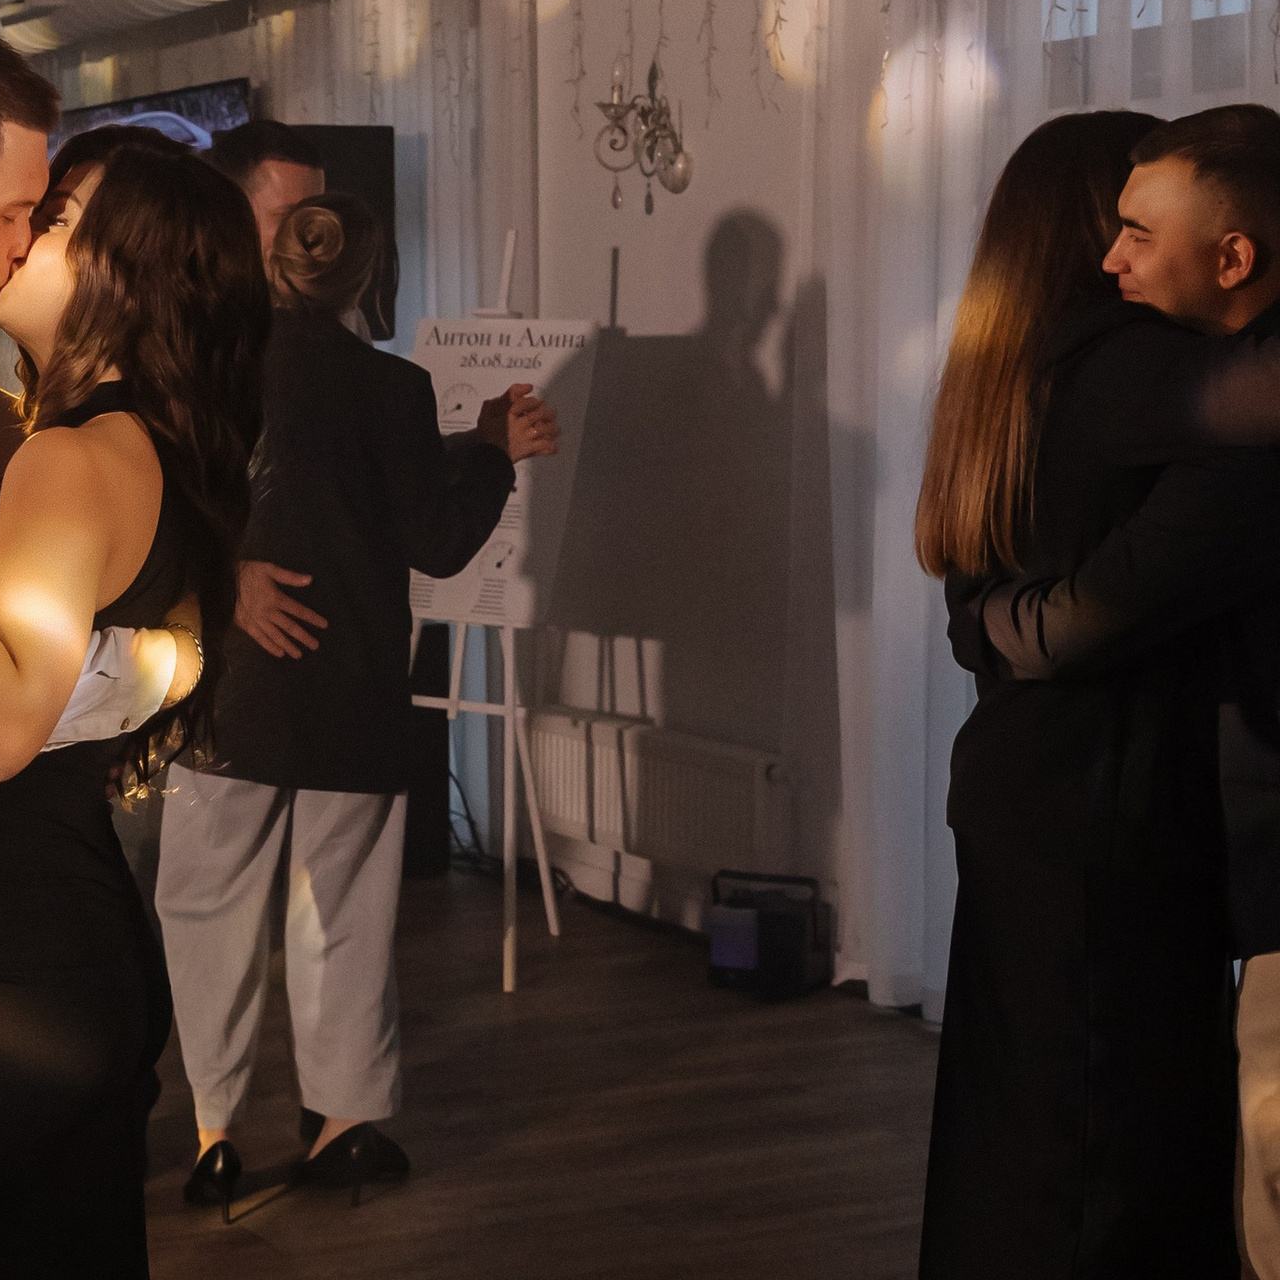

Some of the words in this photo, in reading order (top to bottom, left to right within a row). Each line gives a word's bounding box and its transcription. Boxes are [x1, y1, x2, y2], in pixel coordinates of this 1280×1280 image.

[425, 325, 491, 348] Антон
[498, 332, 511, 347] и
[517, 327, 586, 349] Алина
